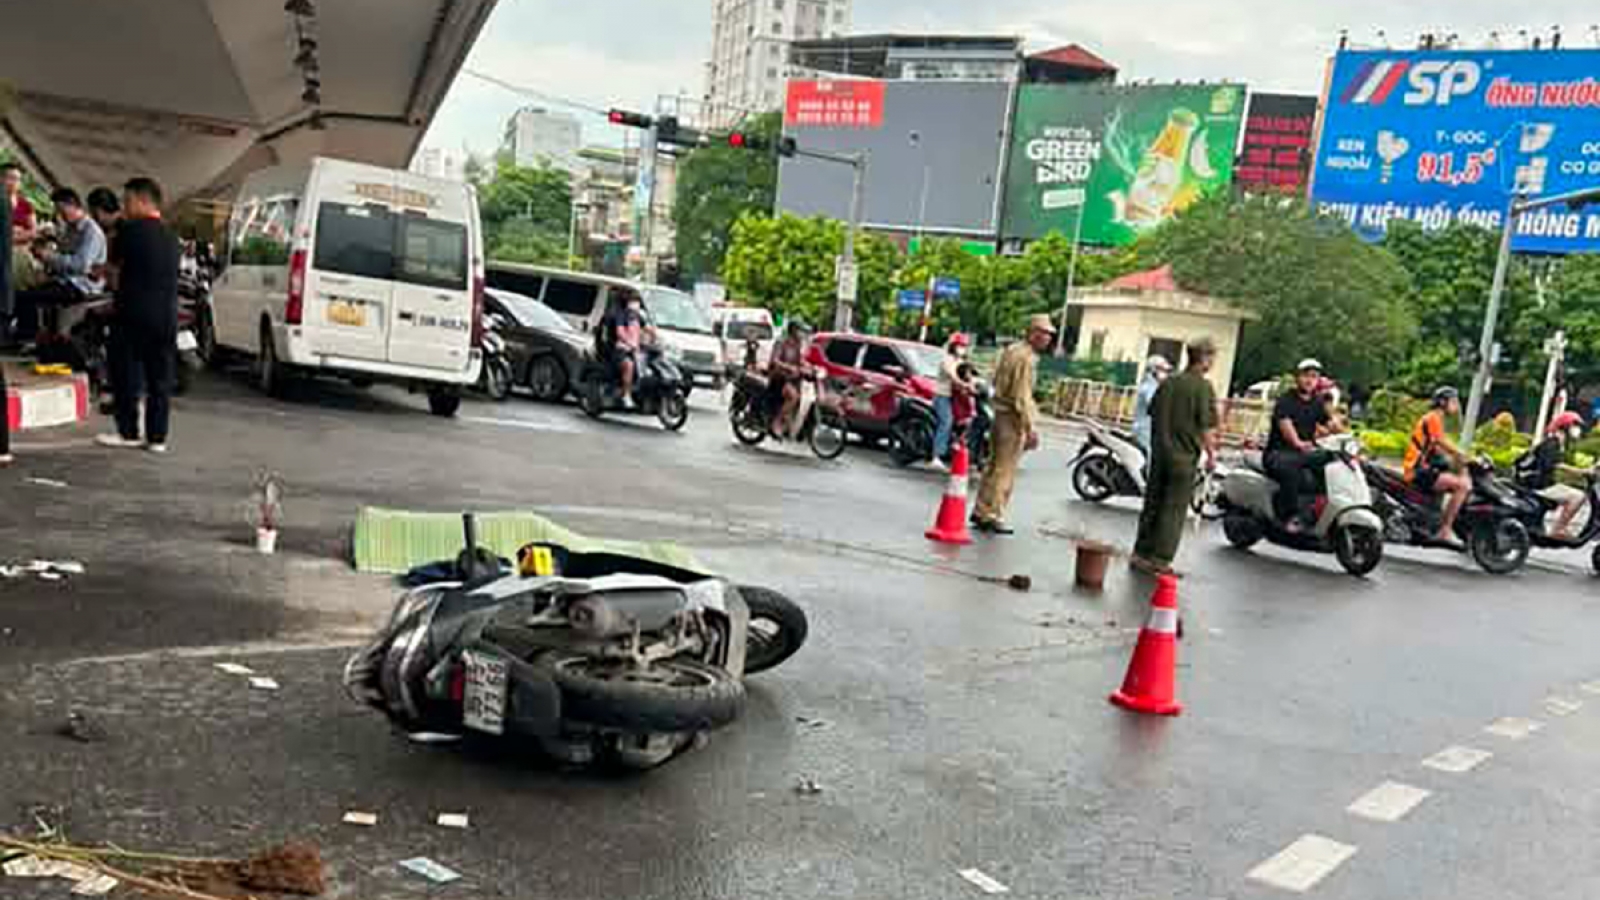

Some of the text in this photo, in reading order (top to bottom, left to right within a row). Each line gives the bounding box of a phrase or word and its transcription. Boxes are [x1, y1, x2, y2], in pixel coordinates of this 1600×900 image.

[1404, 61, 1480, 104] SP
[1027, 139, 1101, 160] GREEN
[1037, 160, 1092, 183] BIRD
